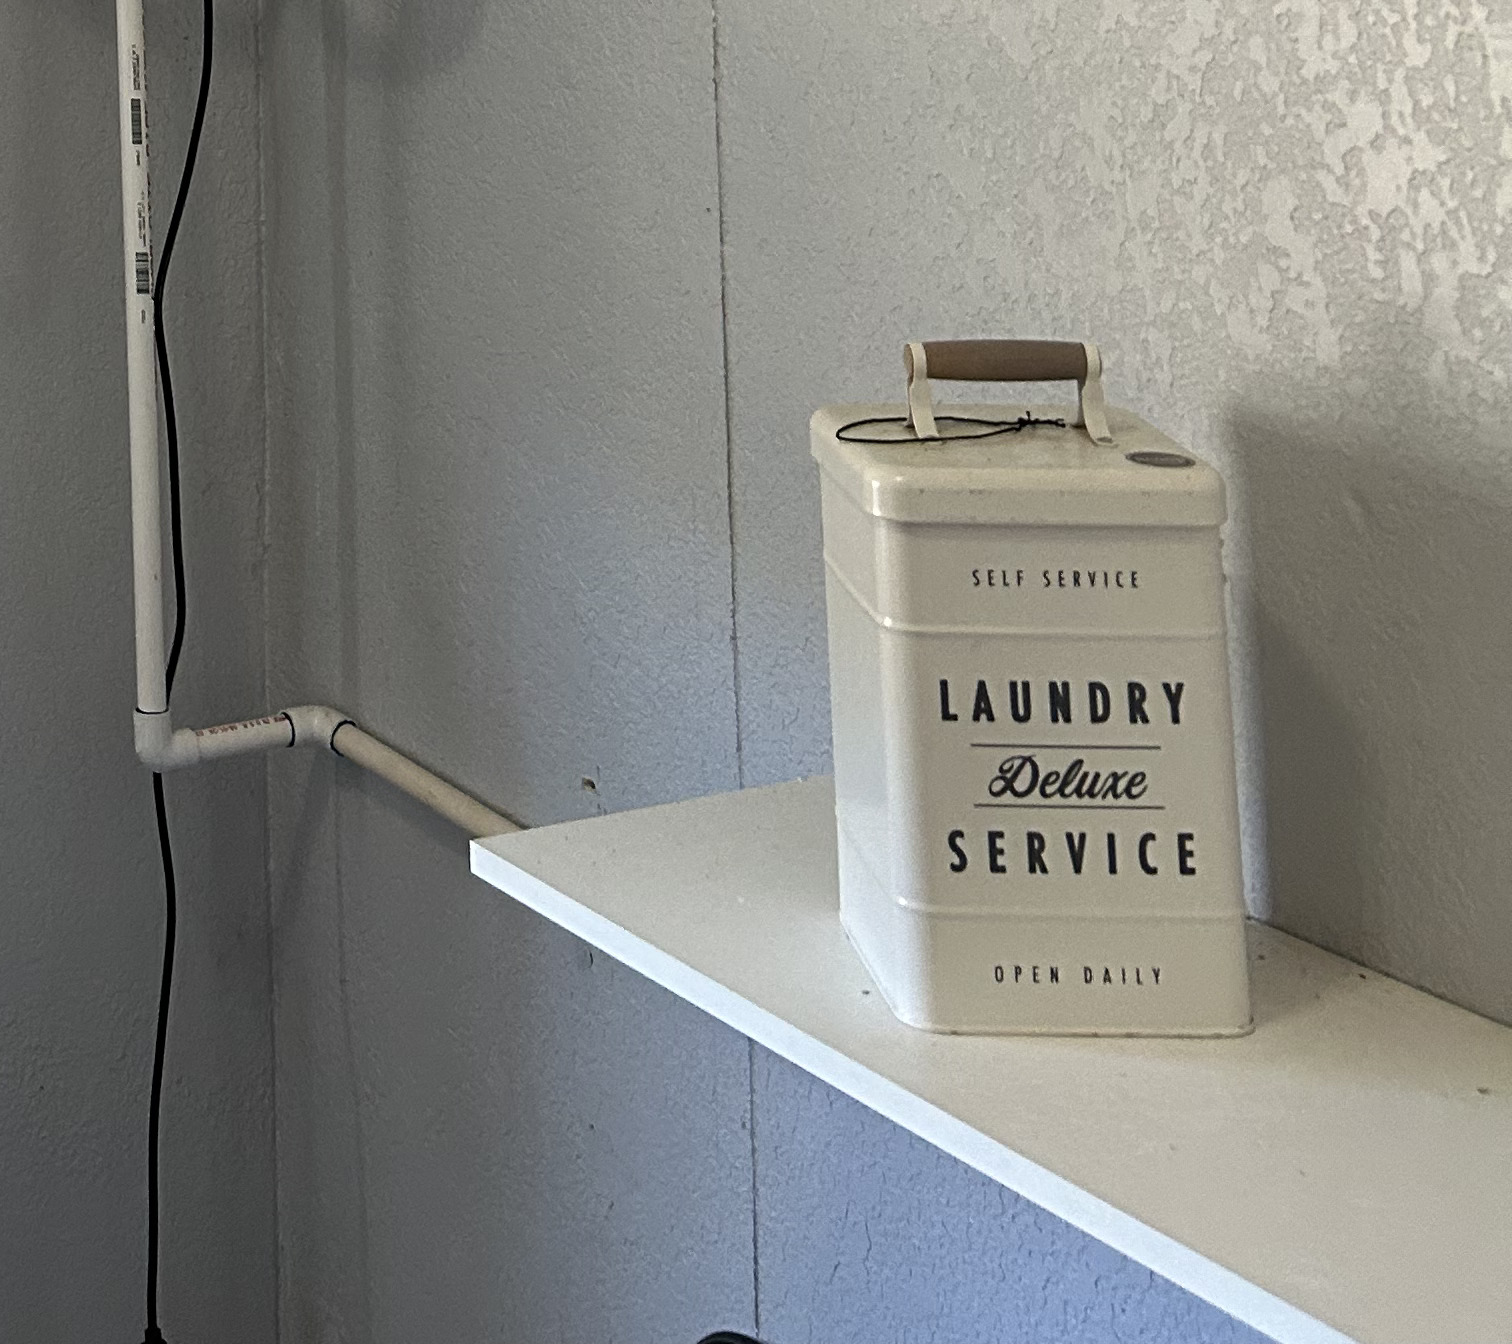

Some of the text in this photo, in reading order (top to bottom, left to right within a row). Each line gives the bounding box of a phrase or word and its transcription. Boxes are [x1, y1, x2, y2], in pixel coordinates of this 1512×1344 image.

[972, 569, 1141, 589] SELF SERVICE
[939, 679, 1185, 725] LAUNDRY
[988, 755, 1148, 801] Deluxe
[947, 829, 1197, 876] SERVICE
[994, 965, 1164, 986] OPEN DAILY
